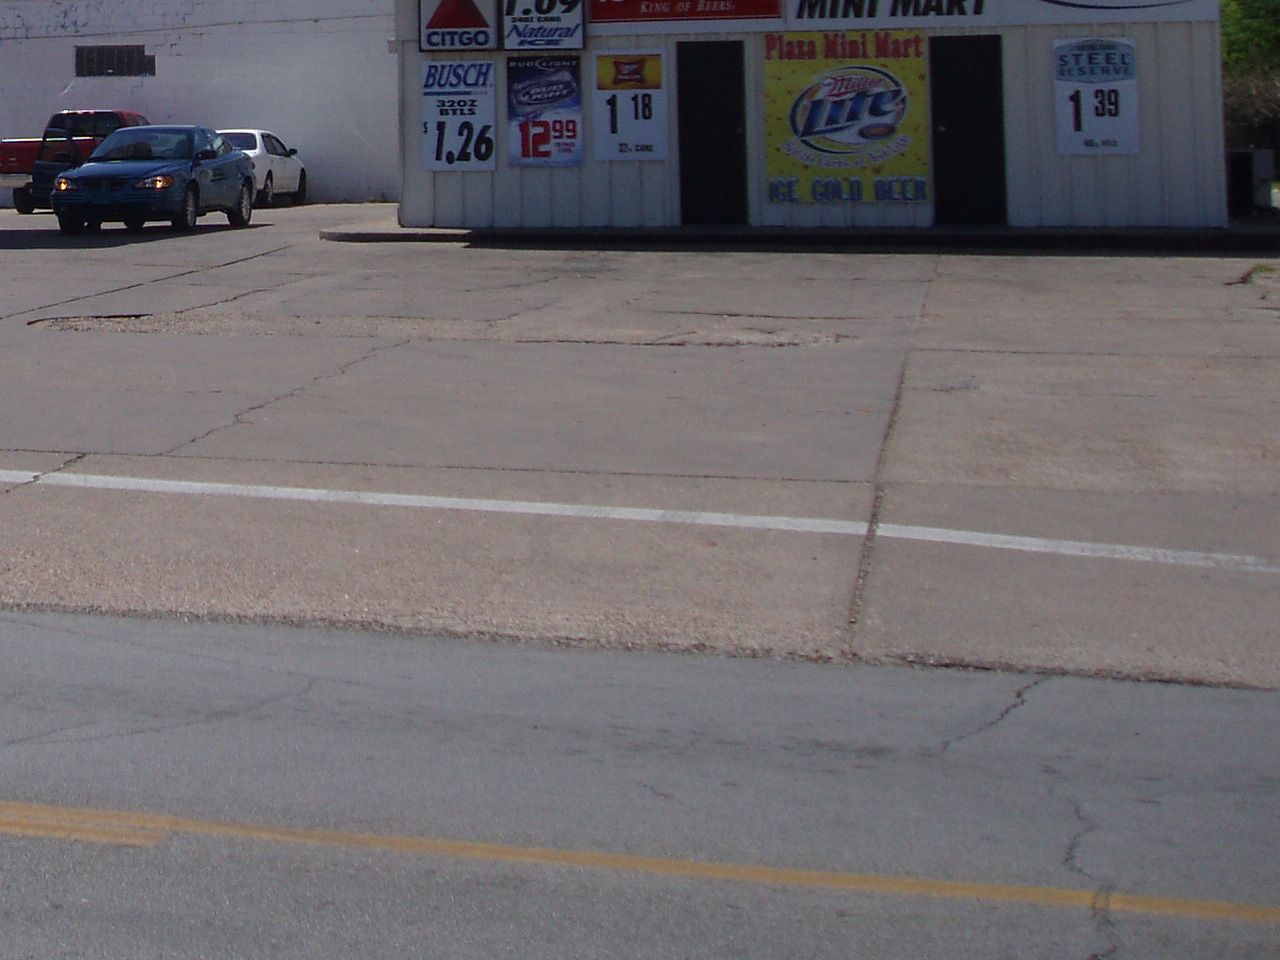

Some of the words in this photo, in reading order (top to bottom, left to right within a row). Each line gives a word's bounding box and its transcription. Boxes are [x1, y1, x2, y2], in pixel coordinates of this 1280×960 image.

[639, 1, 670, 14] KING
[676, 1, 691, 13] OF
[426, 29, 490, 47] CITGO
[506, 23, 580, 39] Natural
[764, 32, 818, 60] Plaza
[824, 31, 868, 59] Mini
[874, 31, 923, 59] Mart
[1058, 52, 1131, 67] STEEL
[422, 62, 493, 88] BUSCH
[1058, 65, 1131, 77] RESERVE
[436, 99, 478, 108] 32OZ
[1069, 89, 1082, 132] 1
[1094, 88, 1119, 118] 39
[439, 108, 476, 117] BTLS
[606, 93, 618, 135] 1
[631, 92, 653, 120] 18
[770, 176, 801, 202] ICE
[812, 176, 863, 201] COLD
[874, 176, 927, 201] BEER
